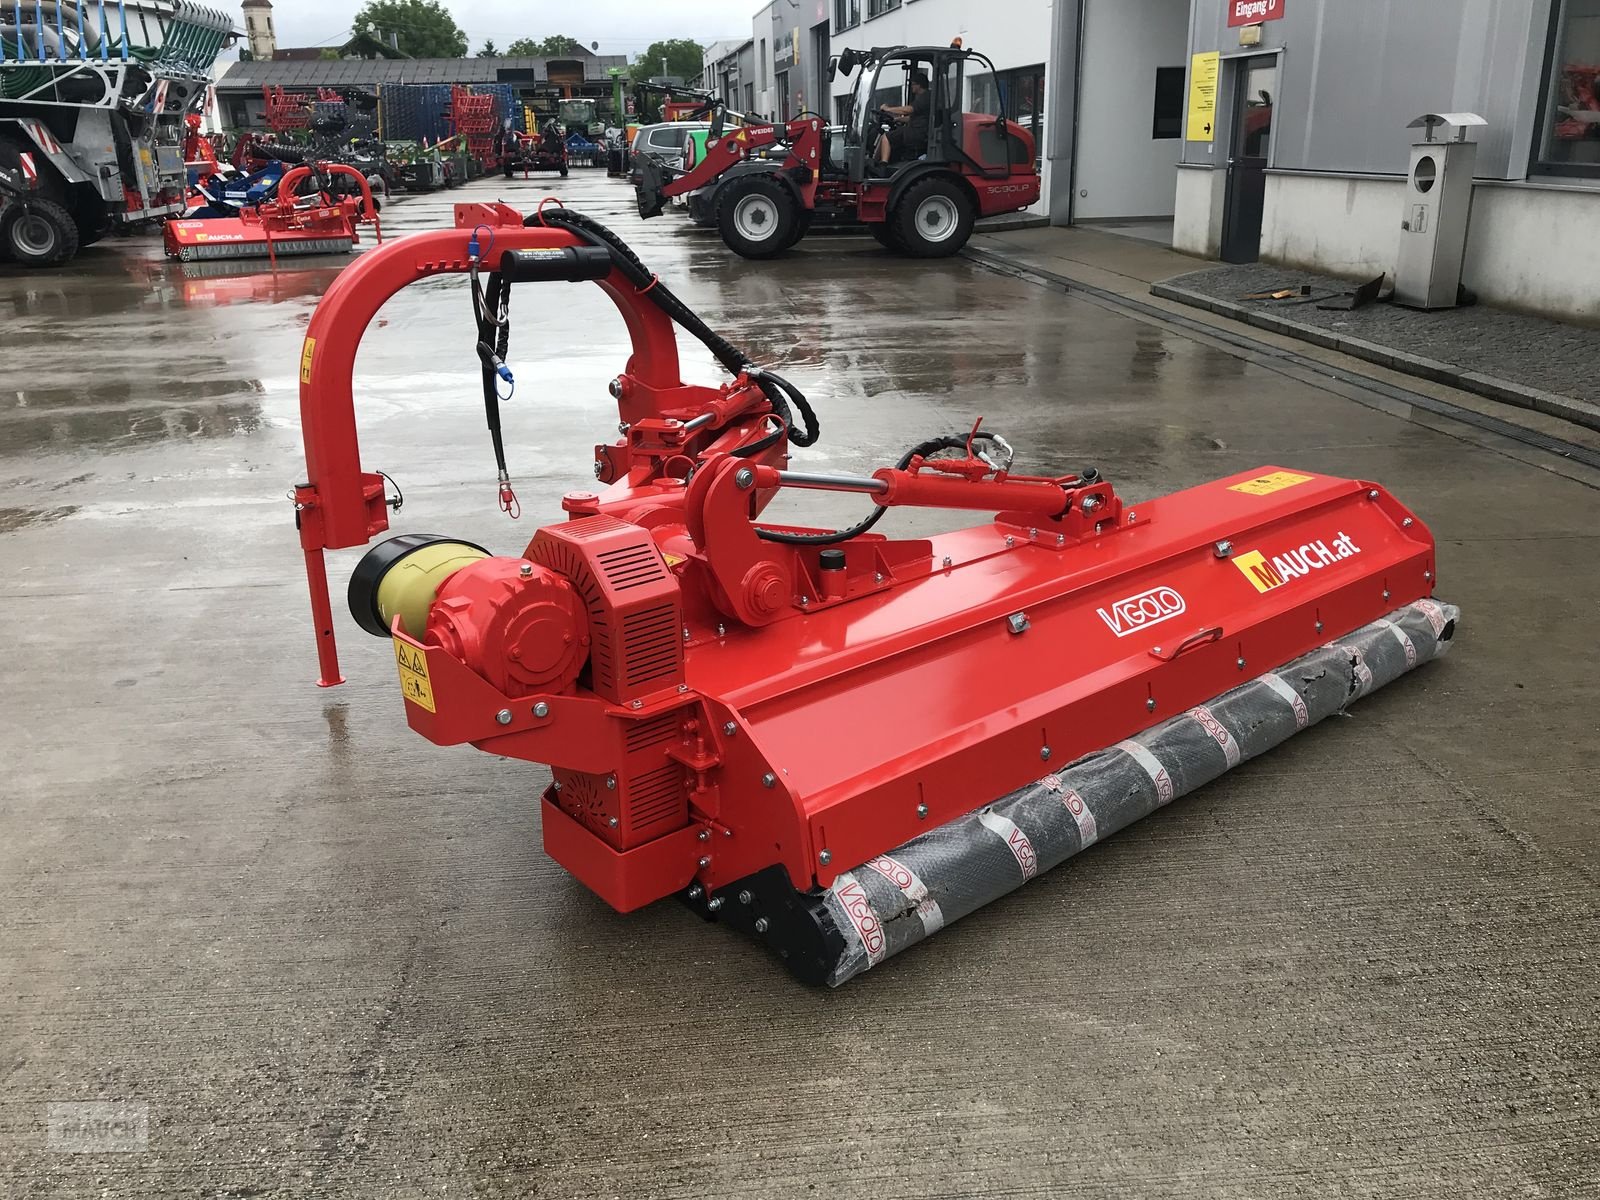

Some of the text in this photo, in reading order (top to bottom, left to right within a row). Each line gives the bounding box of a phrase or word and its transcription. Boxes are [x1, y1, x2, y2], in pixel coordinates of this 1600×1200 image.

[1235, 0, 1276, 18] Eingang D
[1249, 531, 1361, 589] MAUCH.at
[1096, 586, 1187, 637] VIGOLO
[837, 882, 884, 954] VIGOLO
